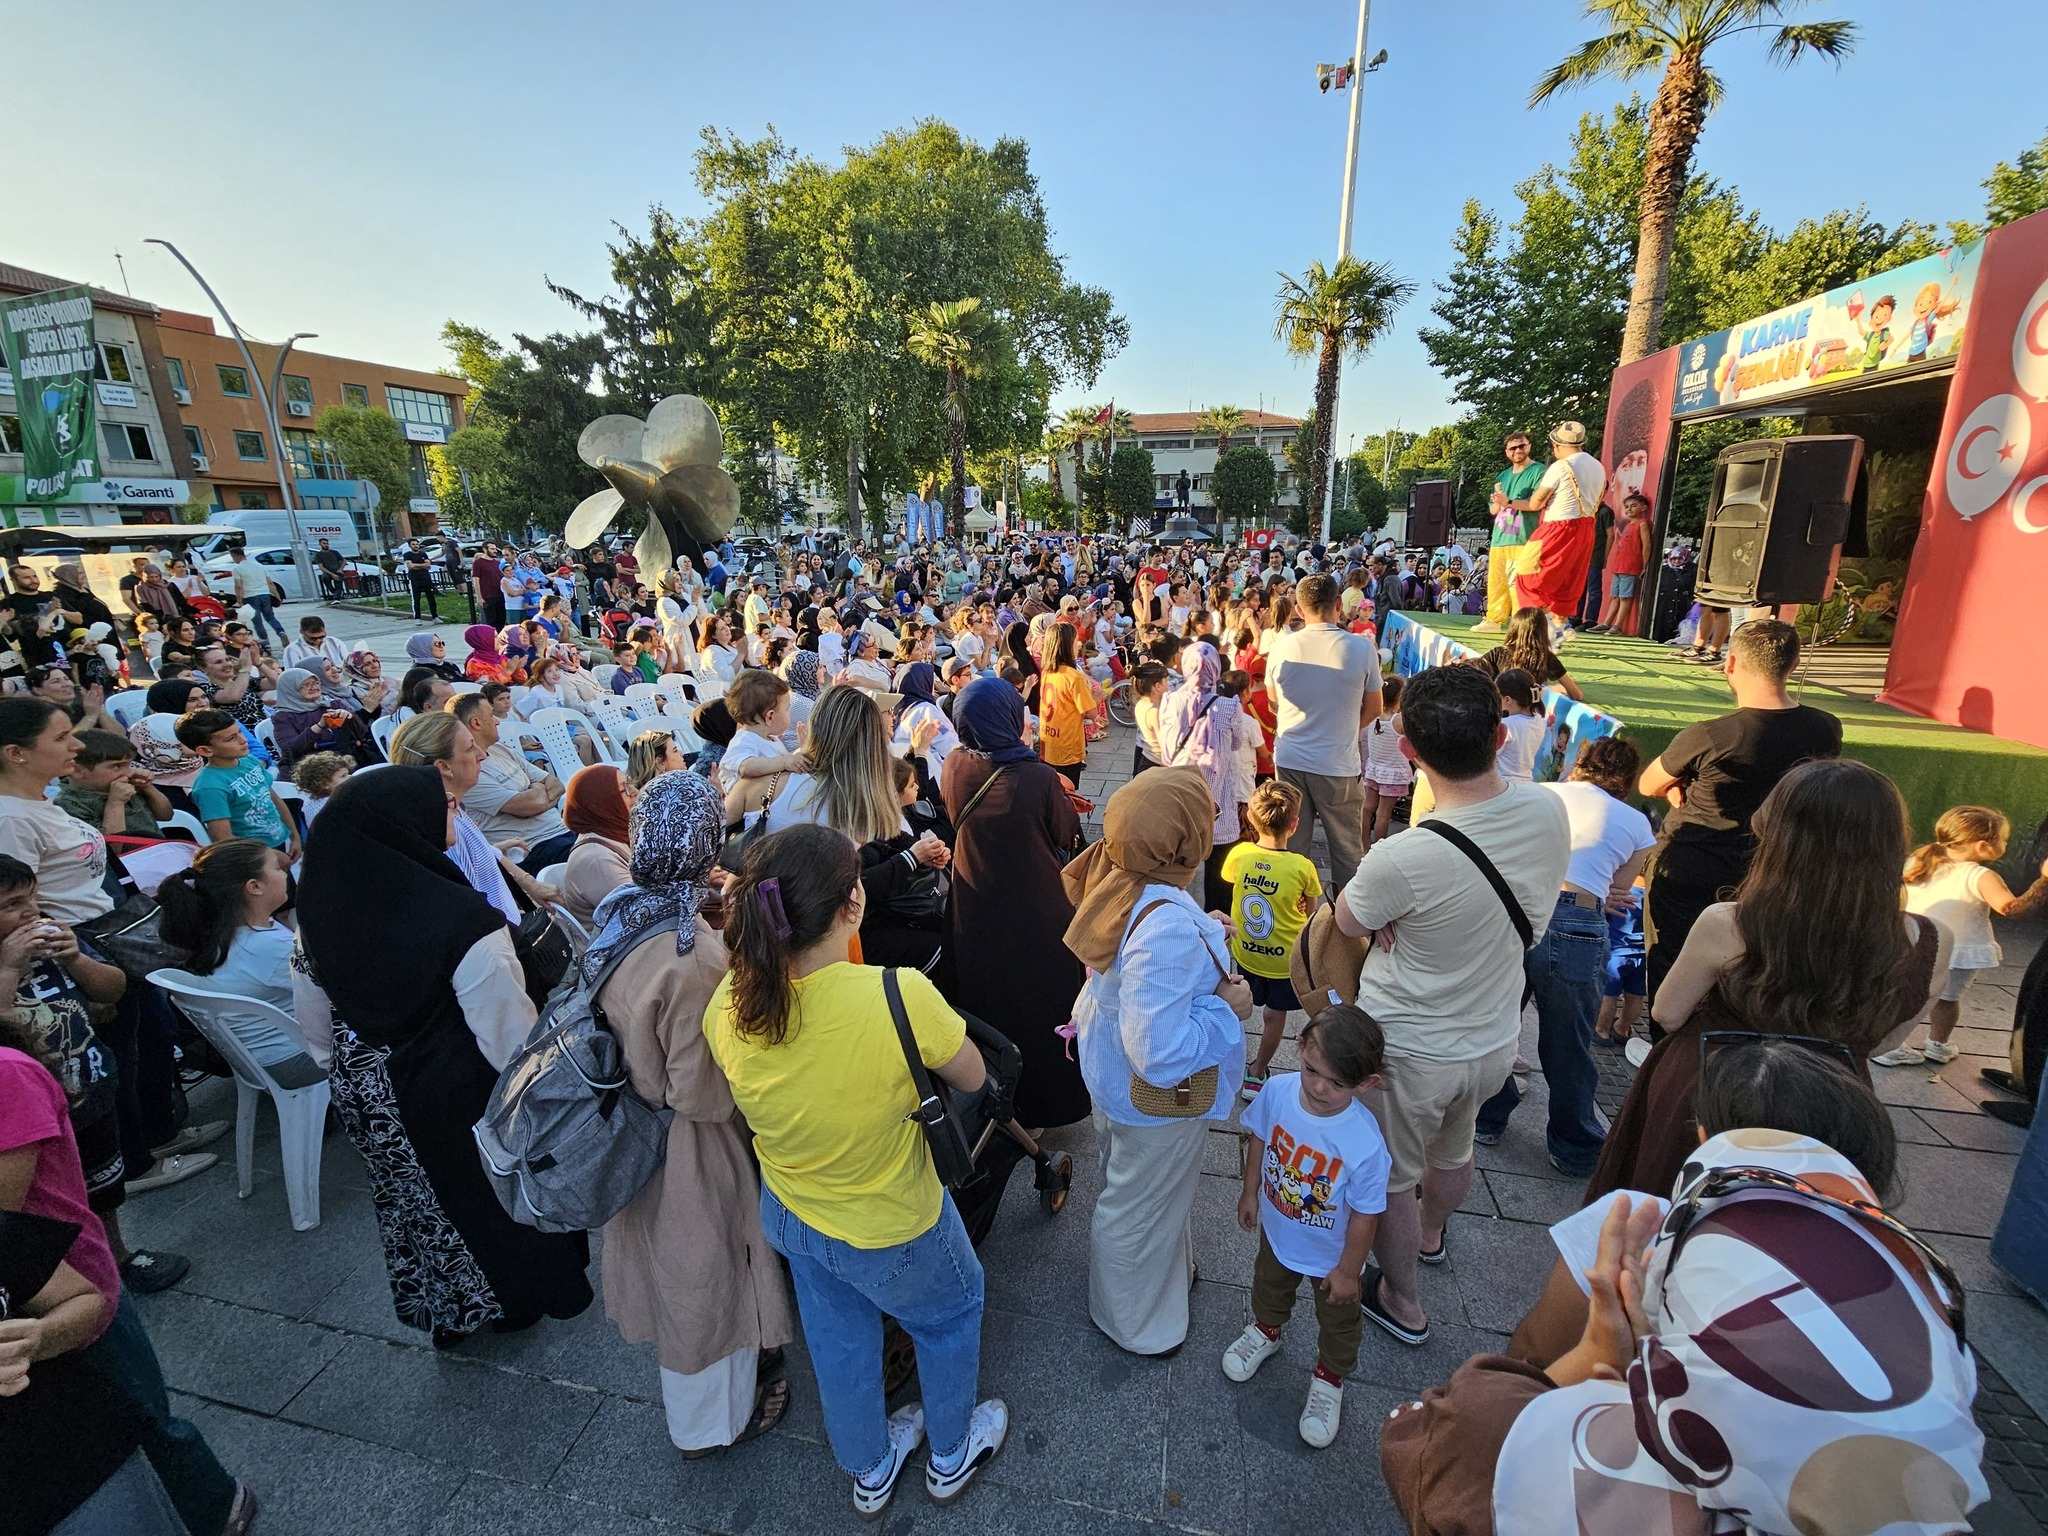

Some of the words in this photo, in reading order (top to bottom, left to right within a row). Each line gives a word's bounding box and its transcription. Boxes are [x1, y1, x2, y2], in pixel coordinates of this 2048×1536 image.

[27, 329, 60, 354] SÜPER
[1740, 306, 1813, 359] KARNE
[123, 485, 175, 499] Garanti
[1243, 873, 1280, 895] halley
[1240, 892, 1275, 941] 9
[1242, 940, 1285, 957] DŽEKO
[1299, 1208, 1336, 1231] PAW
